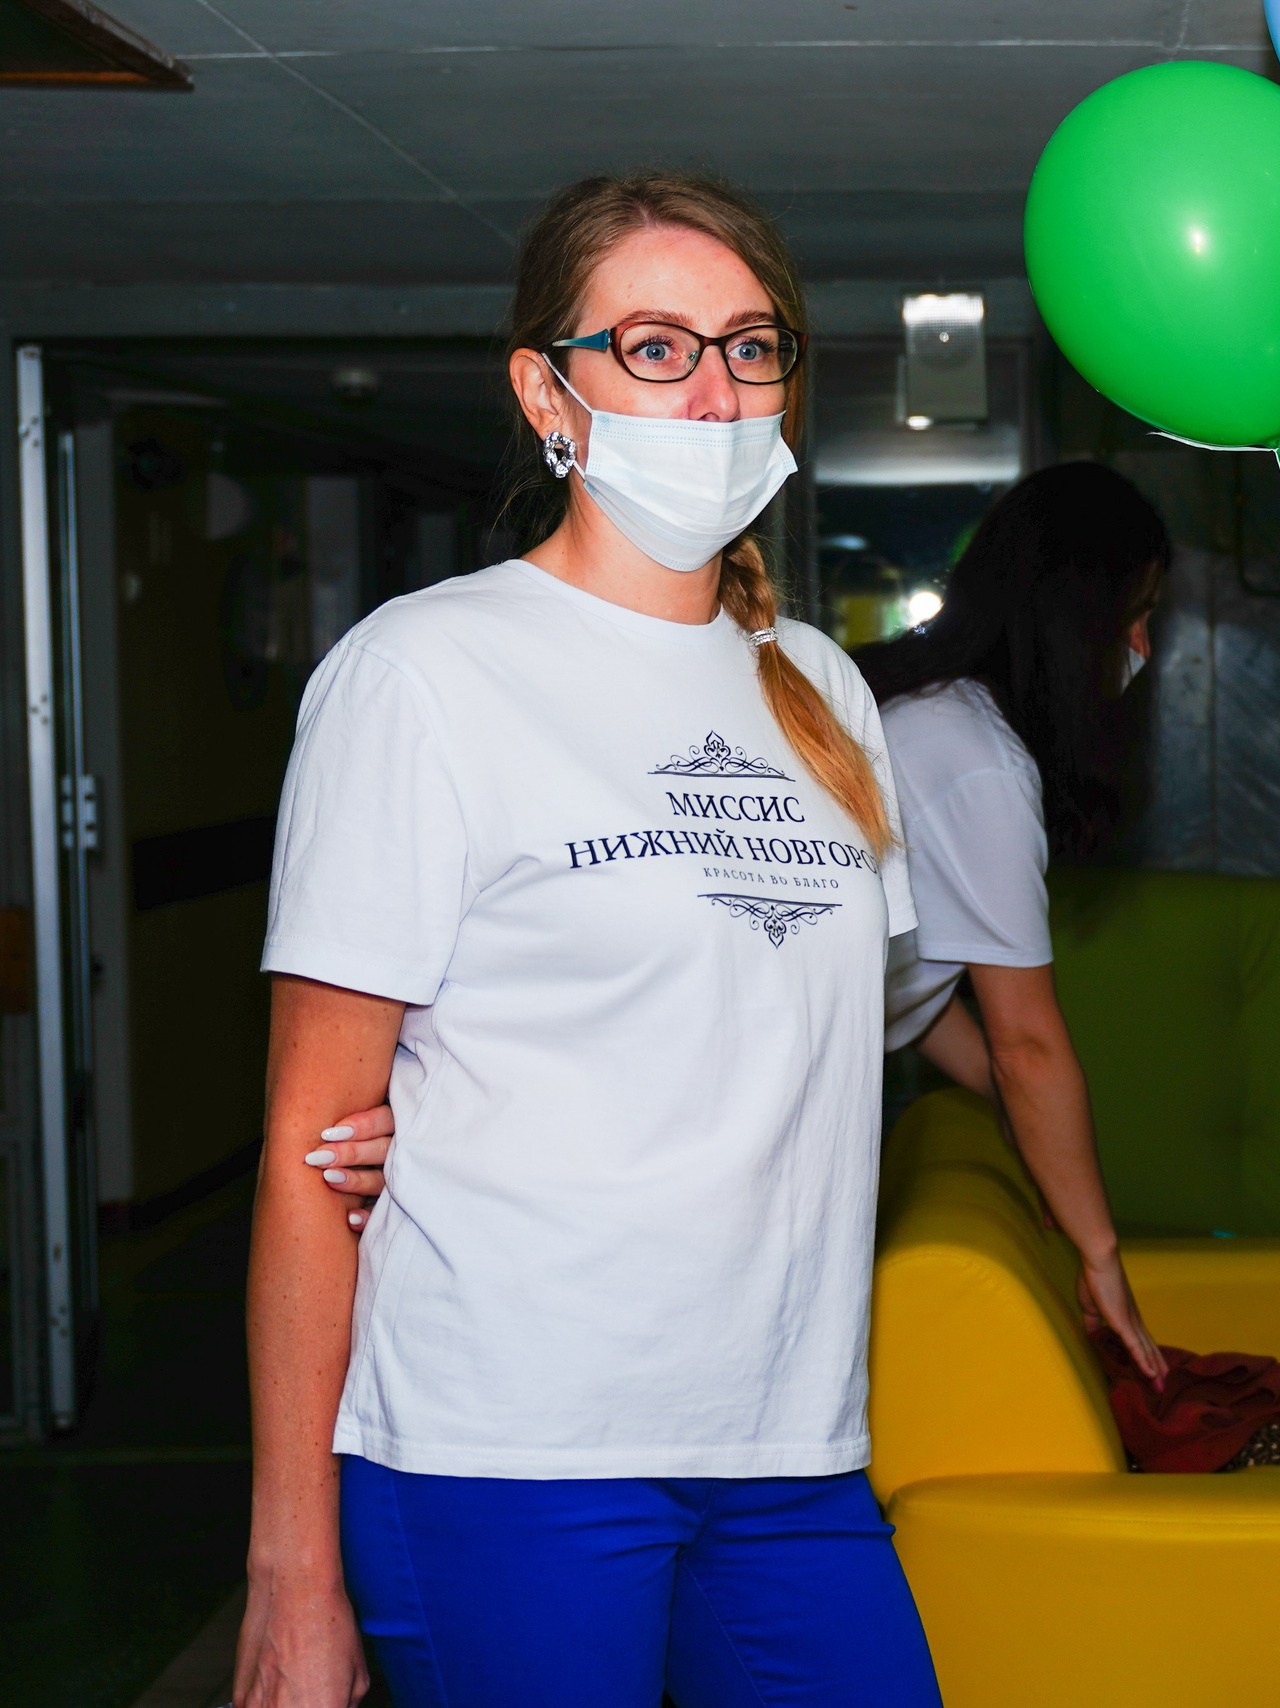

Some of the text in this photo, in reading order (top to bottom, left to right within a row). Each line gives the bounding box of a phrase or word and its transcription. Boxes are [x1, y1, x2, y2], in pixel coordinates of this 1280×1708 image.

[665, 791, 805, 823] МИССИС
[564, 828, 880, 875] НИЖНИЙ НОВГОРО
[703, 867, 839, 889] КРАСОТА ВО БЛАГО
